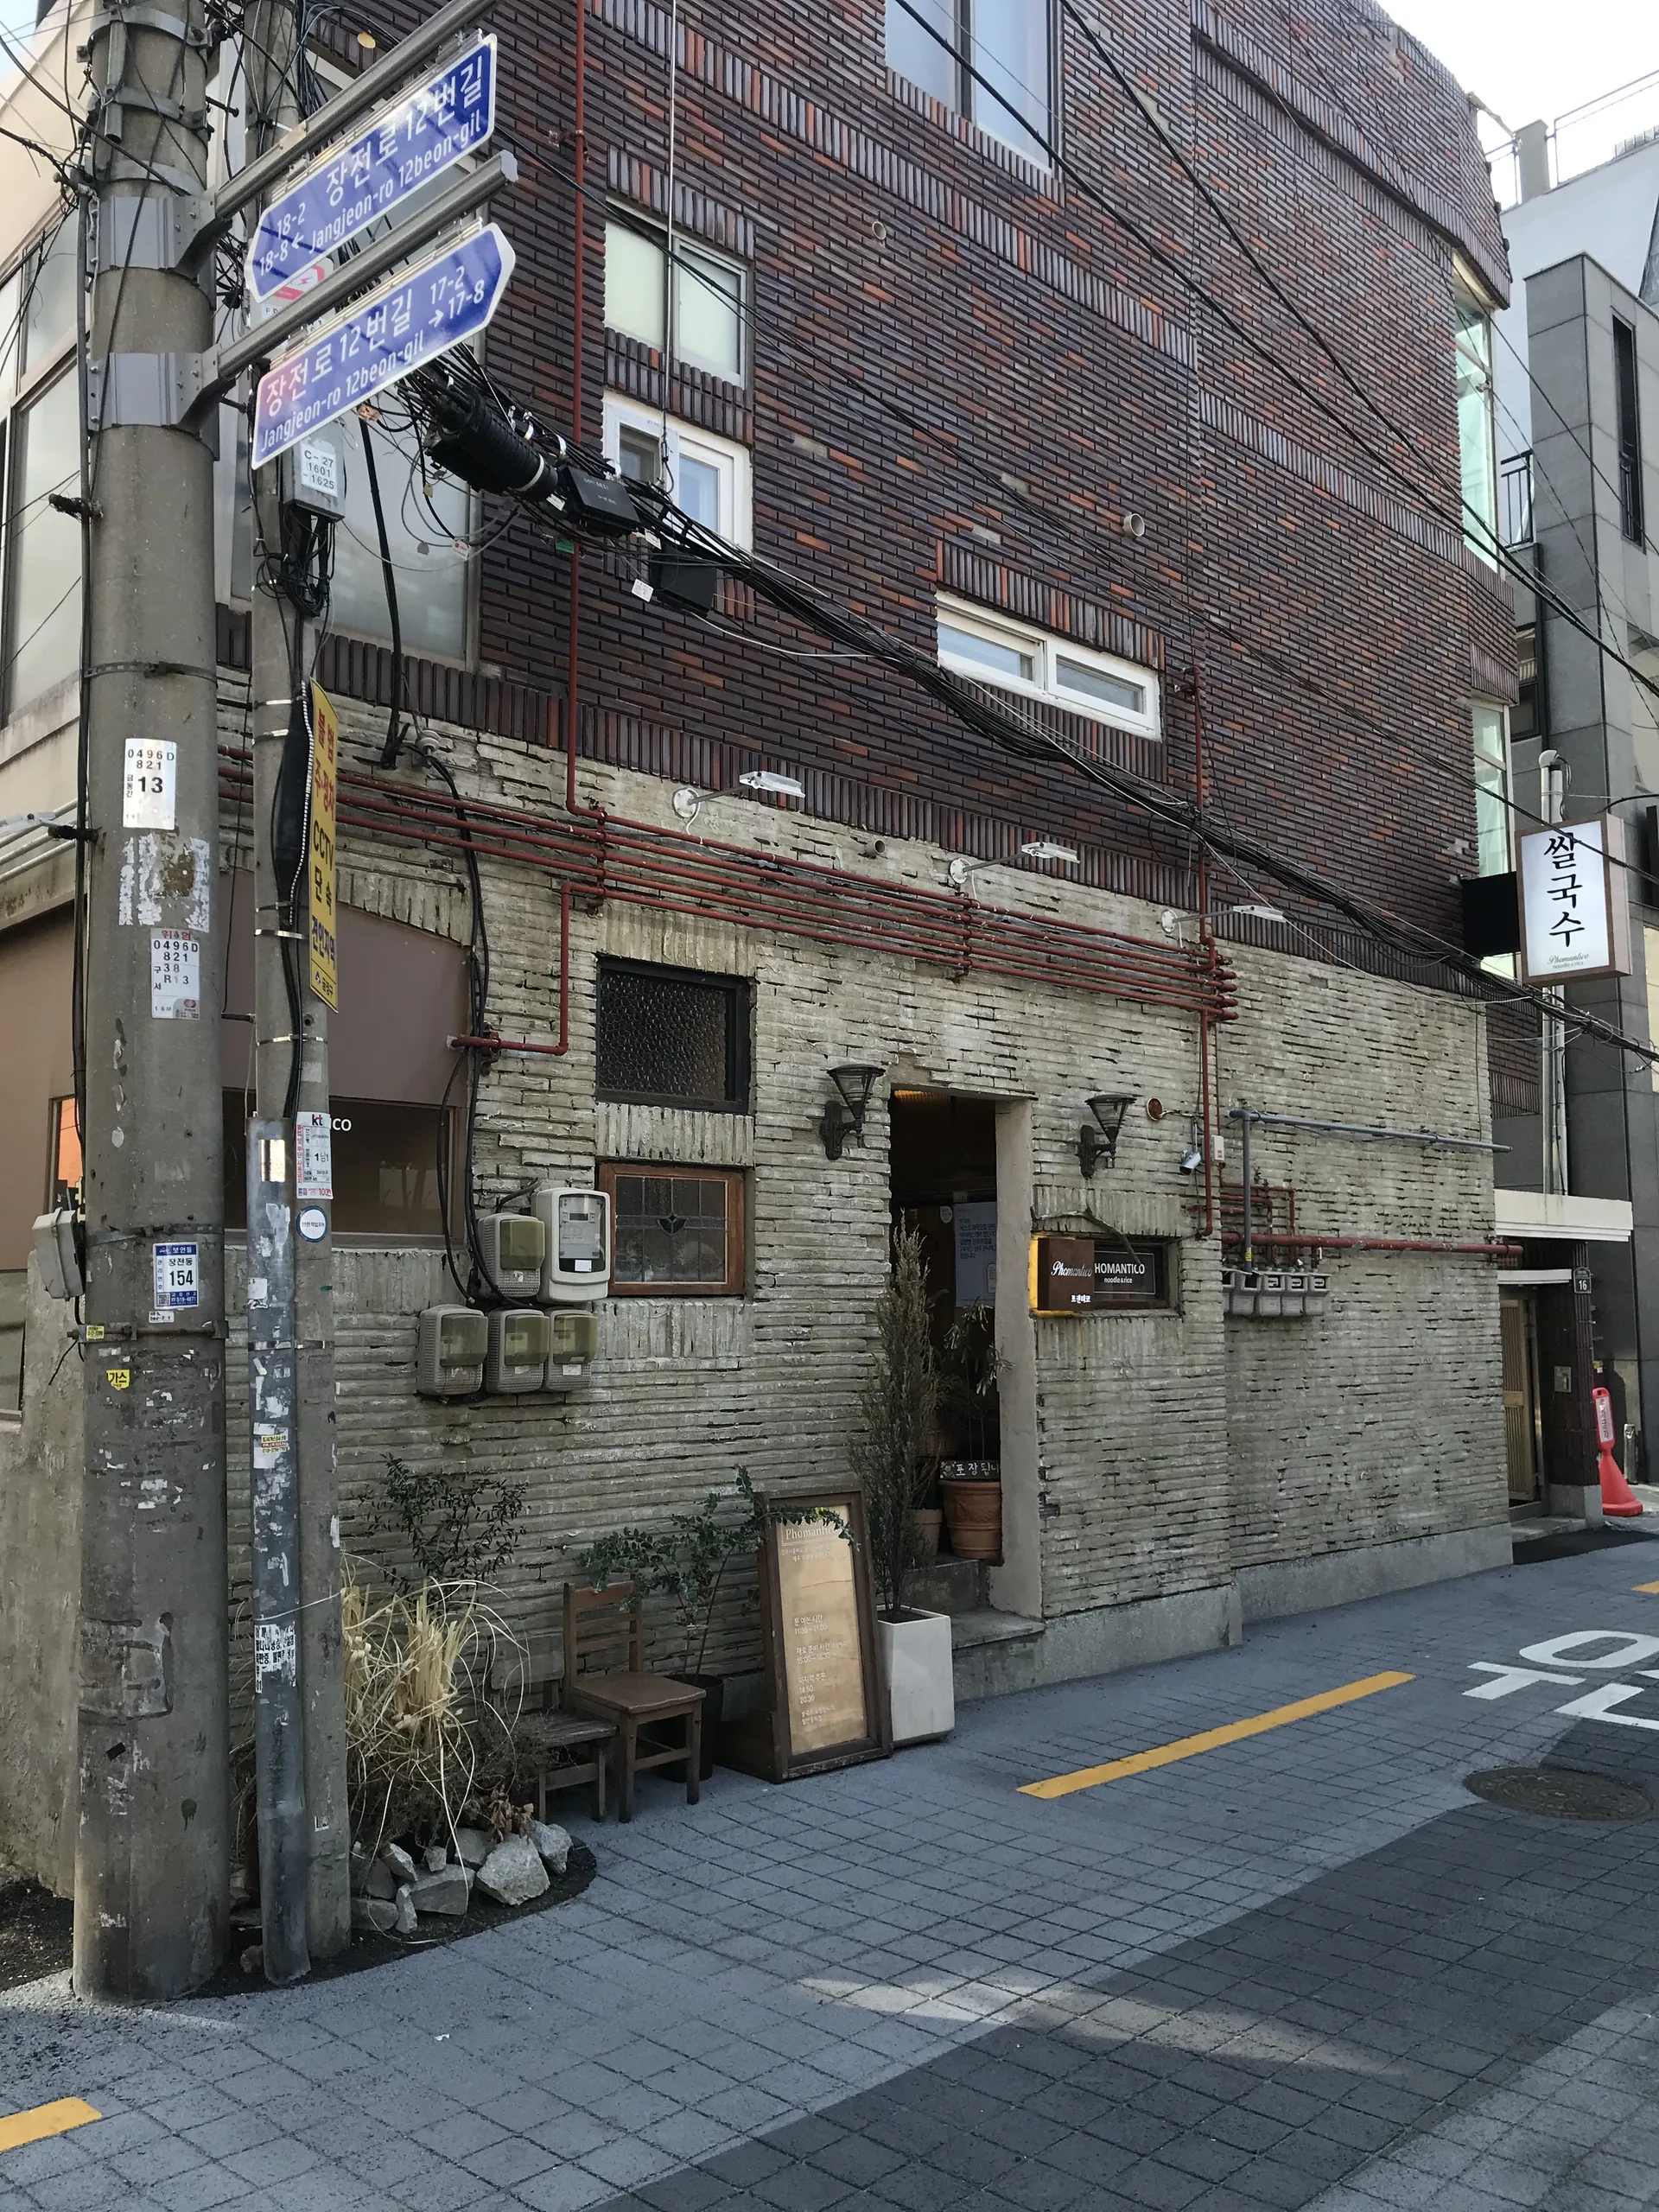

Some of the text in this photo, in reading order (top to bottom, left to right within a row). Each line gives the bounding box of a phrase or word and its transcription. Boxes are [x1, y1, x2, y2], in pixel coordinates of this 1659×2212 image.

[308, 108, 481, 255] Jangjeon-ro 12beon-gil
[276, 201, 306, 240] 18-2
[259, 241, 289, 276] 18-8
[429, 265, 466, 306] 17-2
[448, 279, 486, 321] 17-8
[259, 327, 425, 454] Jangjeon-ro 12beon-gil
[308, 462, 331, 477] 1601
[318, 709, 334, 765] 불법
[137, 760, 162, 770] 821
[137, 776, 163, 793] 13
[315, 757, 334, 822] 주정차
[313, 819, 334, 872] CCTV
[315, 865, 333, 916] 단속
[1543, 831, 1586, 947] 쌀국수
[154, 939, 199, 952] 0496D
[312, 914, 335, 971] 견인지역
[163, 951, 188, 963] 821
[1547, 951, 1589, 965] Phomantico
[163, 963, 180, 973] 38
[311, 1114, 323, 1126] kt
[168, 1257, 193, 1267] 장전동
[1050, 1261, 1093, 1277] Phomantico
[169, 1269, 194, 1286] 154
[1579, 1280, 1587, 1290] 16
[109, 1372, 127, 1383] 가스
[812, 1614, 823, 1624] 시간
